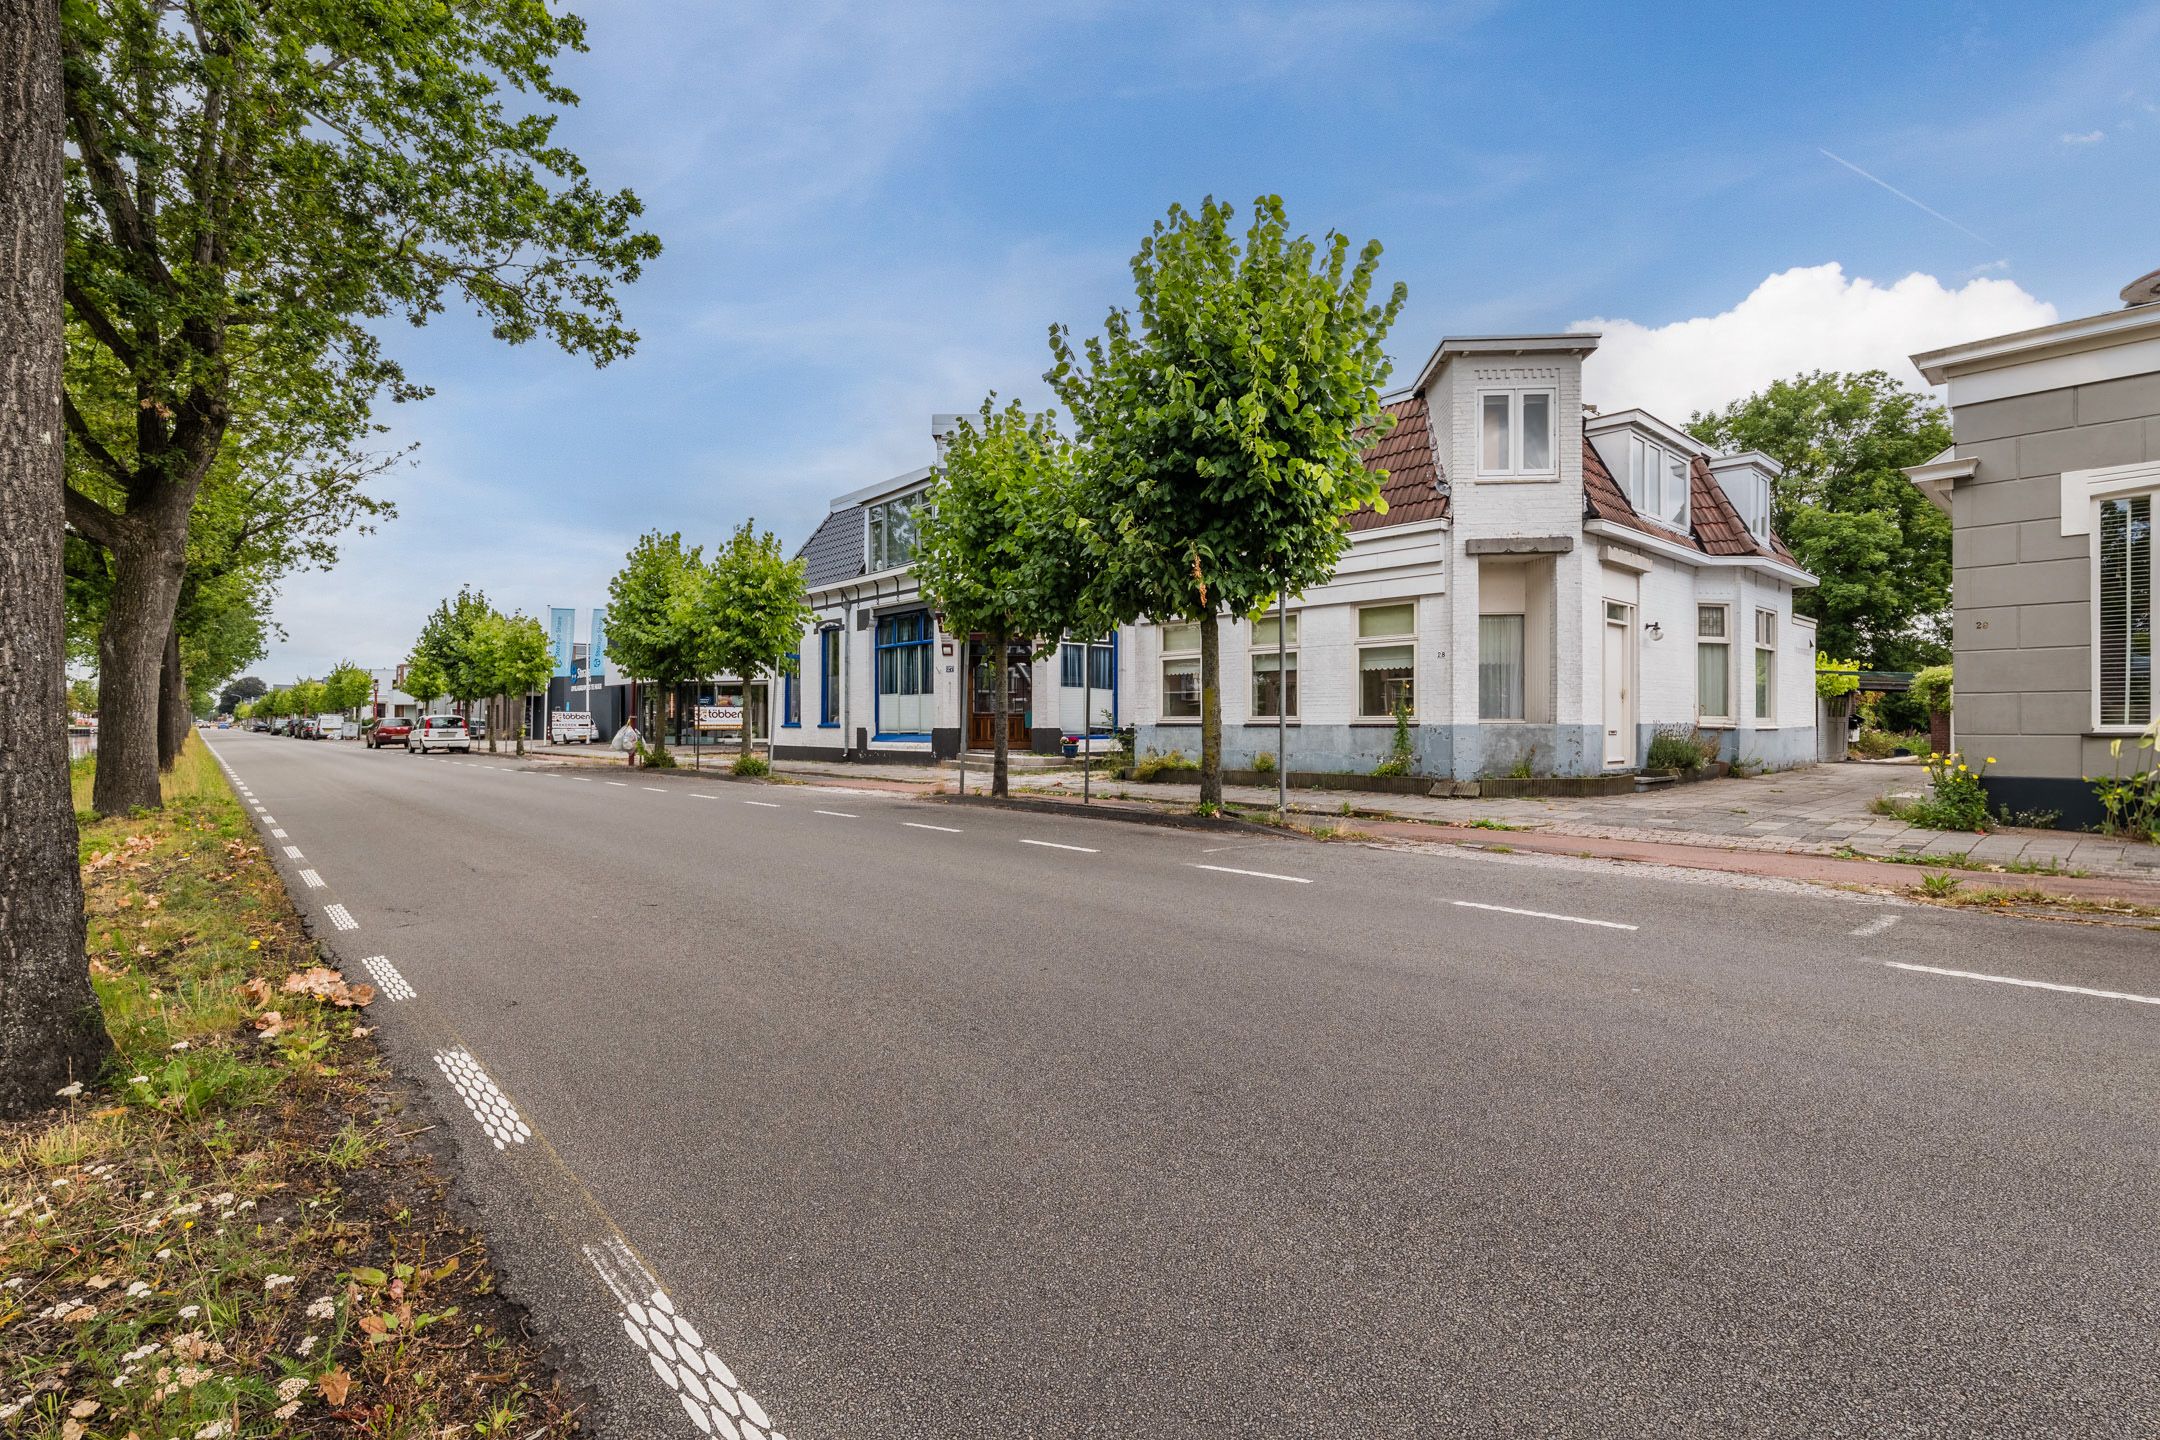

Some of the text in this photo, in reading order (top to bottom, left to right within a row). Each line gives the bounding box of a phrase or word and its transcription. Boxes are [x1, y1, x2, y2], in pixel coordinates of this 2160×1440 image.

[595, 634, 603, 657] Storage
[1437, 651, 1446, 659] 28
[708, 709, 743, 719] többen
